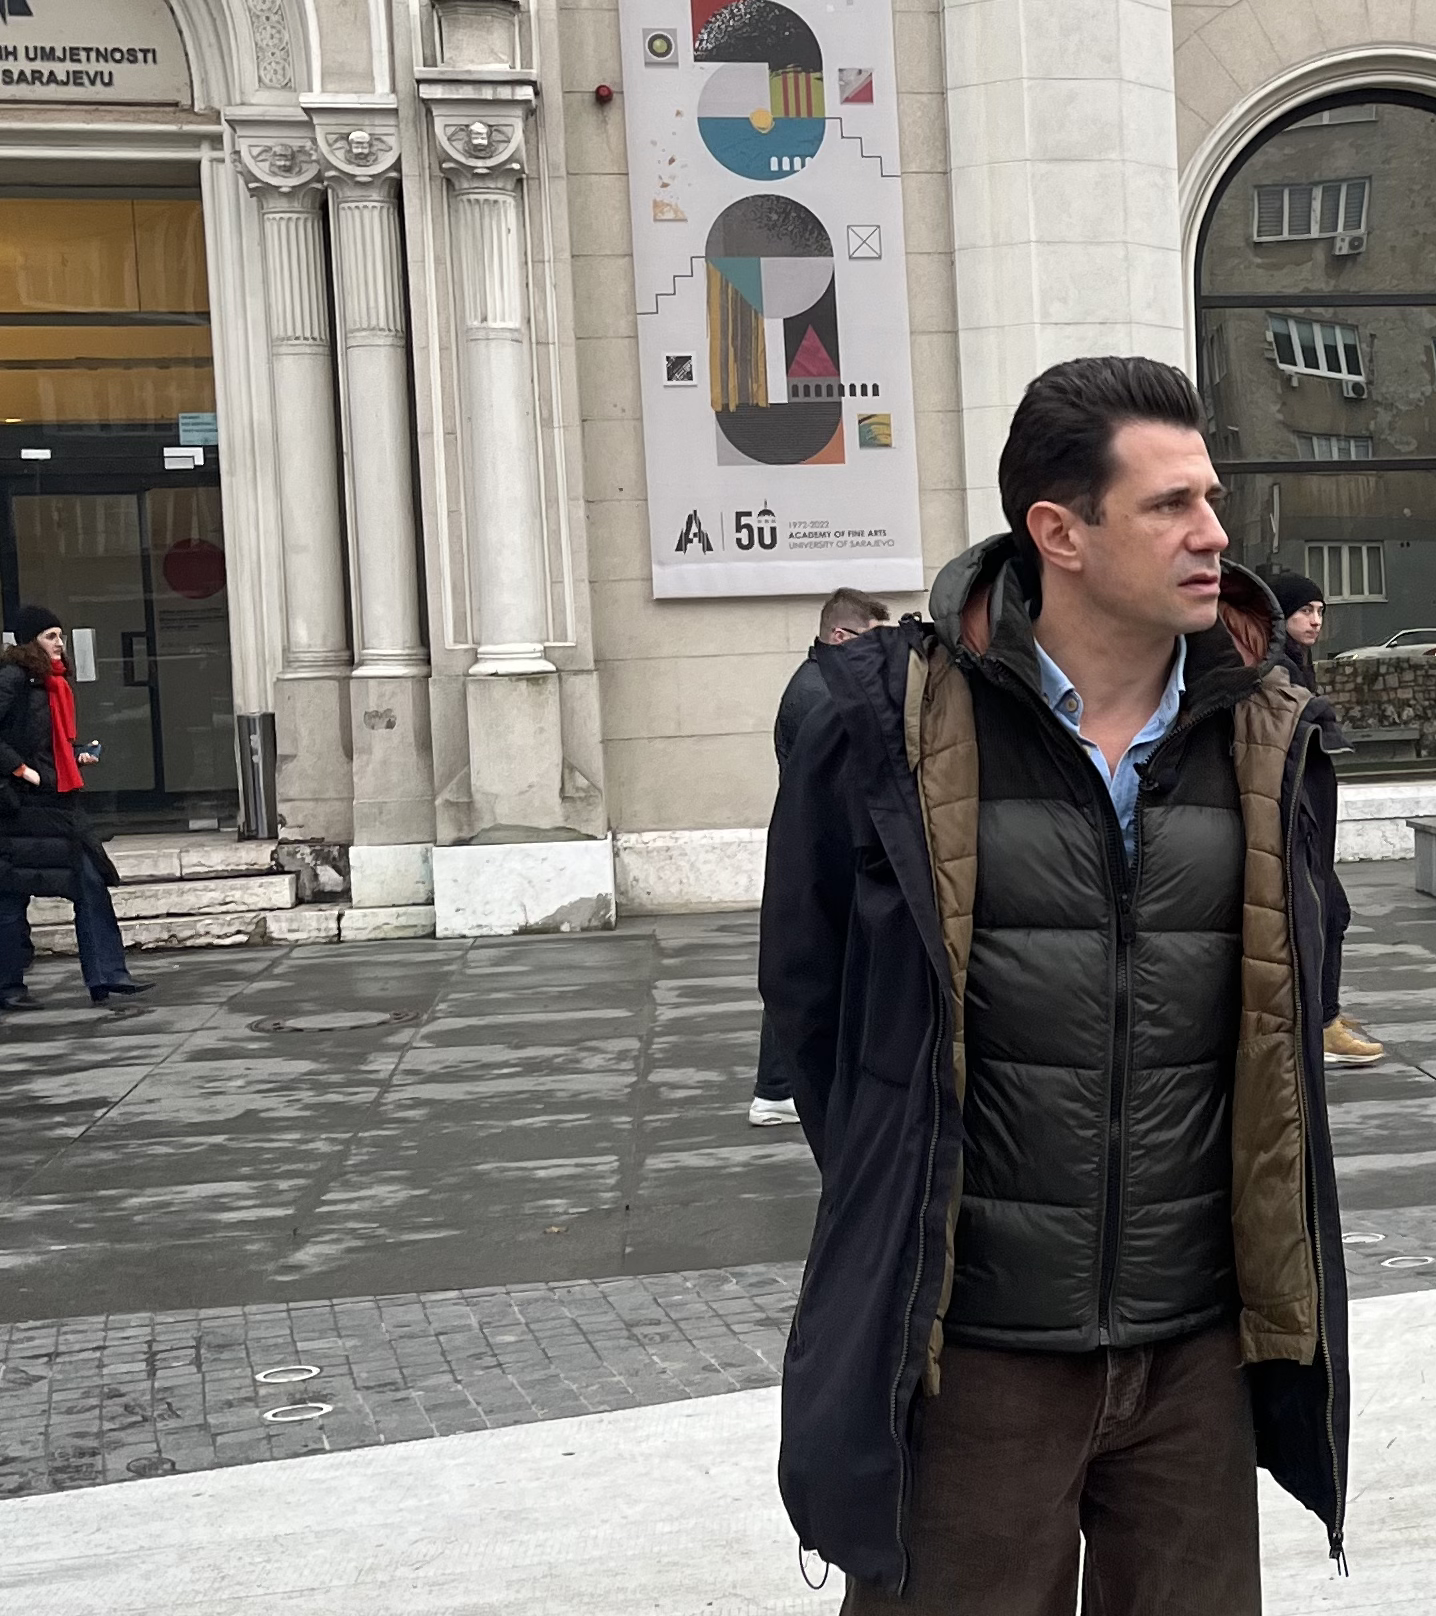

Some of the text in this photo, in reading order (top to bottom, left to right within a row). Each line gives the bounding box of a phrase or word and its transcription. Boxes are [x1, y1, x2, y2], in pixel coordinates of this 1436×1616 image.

[24, 45, 157, 65] UMJETNOSTI
[2, 69, 114, 87] SARAJEVU
[788, 520, 830, 529] 1972-2022
[788, 529, 887, 539] ACADEMY OF FINE ARTS
[788, 539, 895, 550] UNIVERSITY OF SARAJEVO
